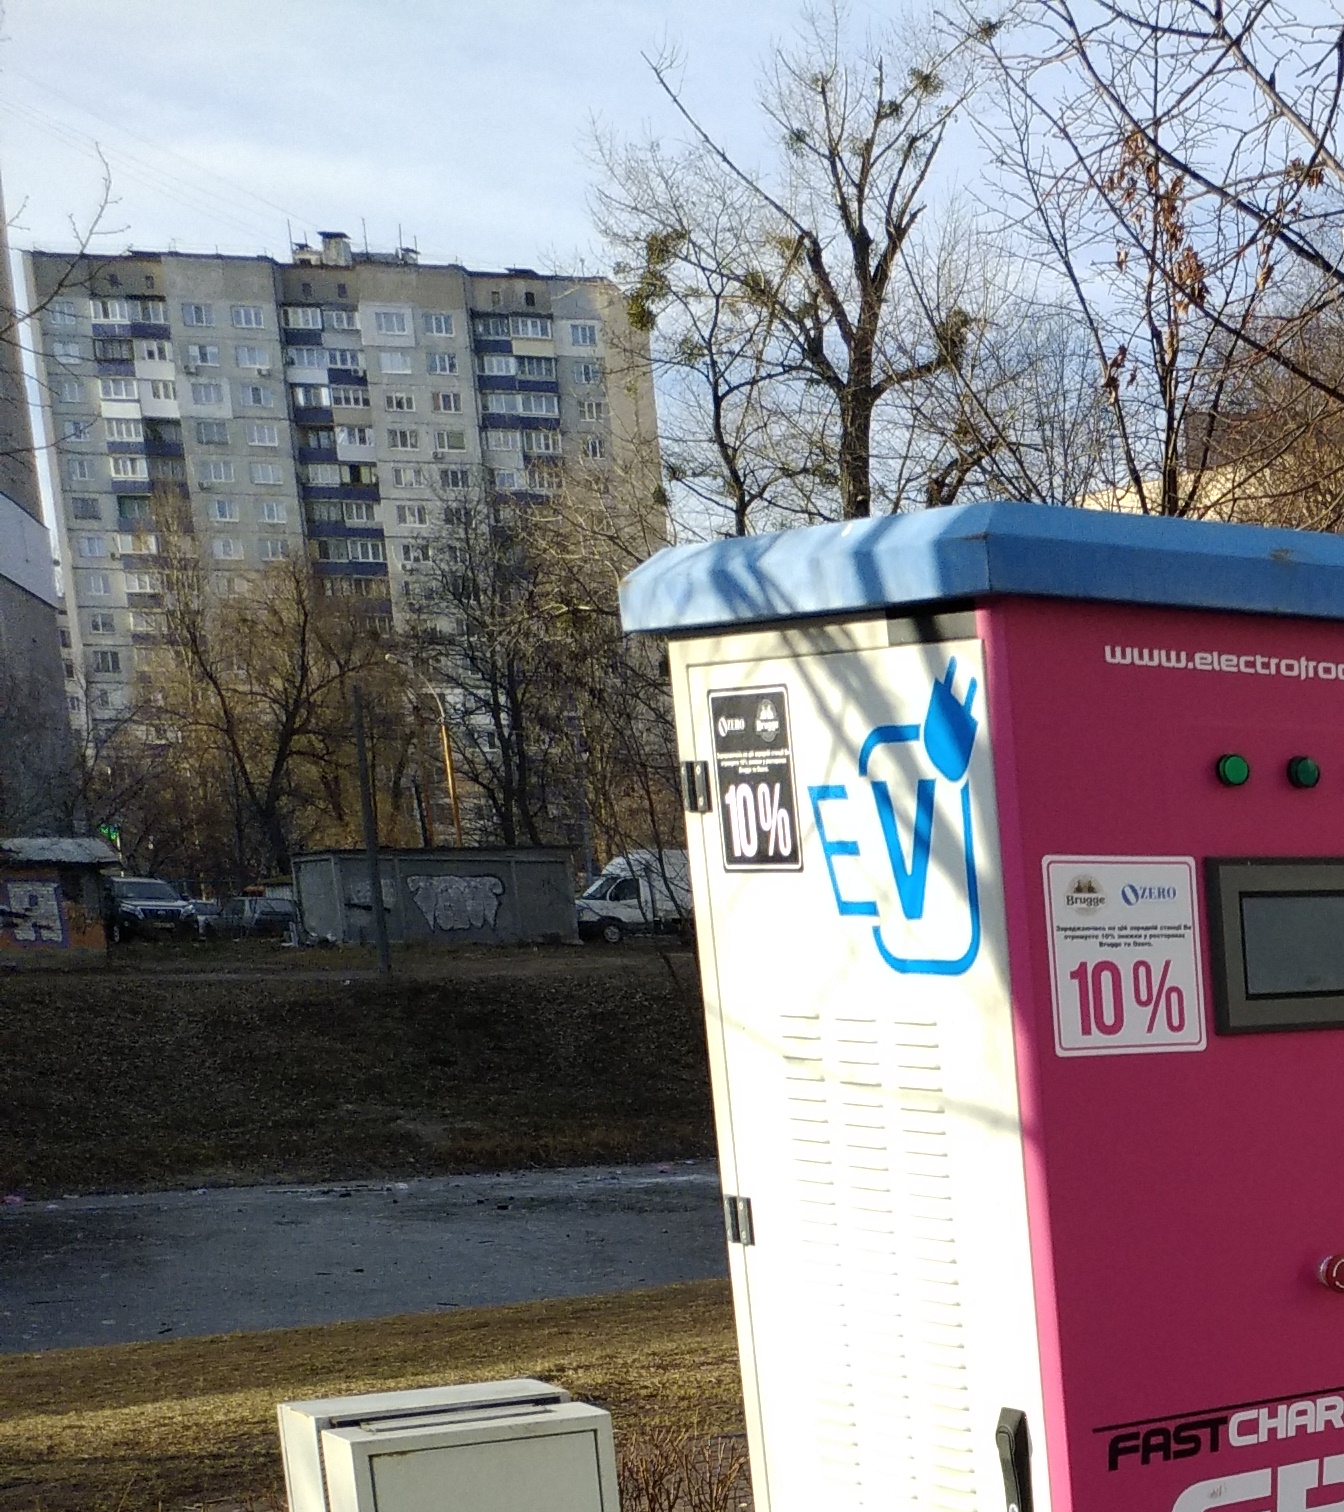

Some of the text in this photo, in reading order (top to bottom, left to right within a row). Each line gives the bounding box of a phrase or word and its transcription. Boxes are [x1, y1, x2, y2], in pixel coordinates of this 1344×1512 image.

[724, 782, 792, 858] 10%
[1065, 894, 1106, 907] Brugge
[1069, 959, 1186, 1037] 10%
